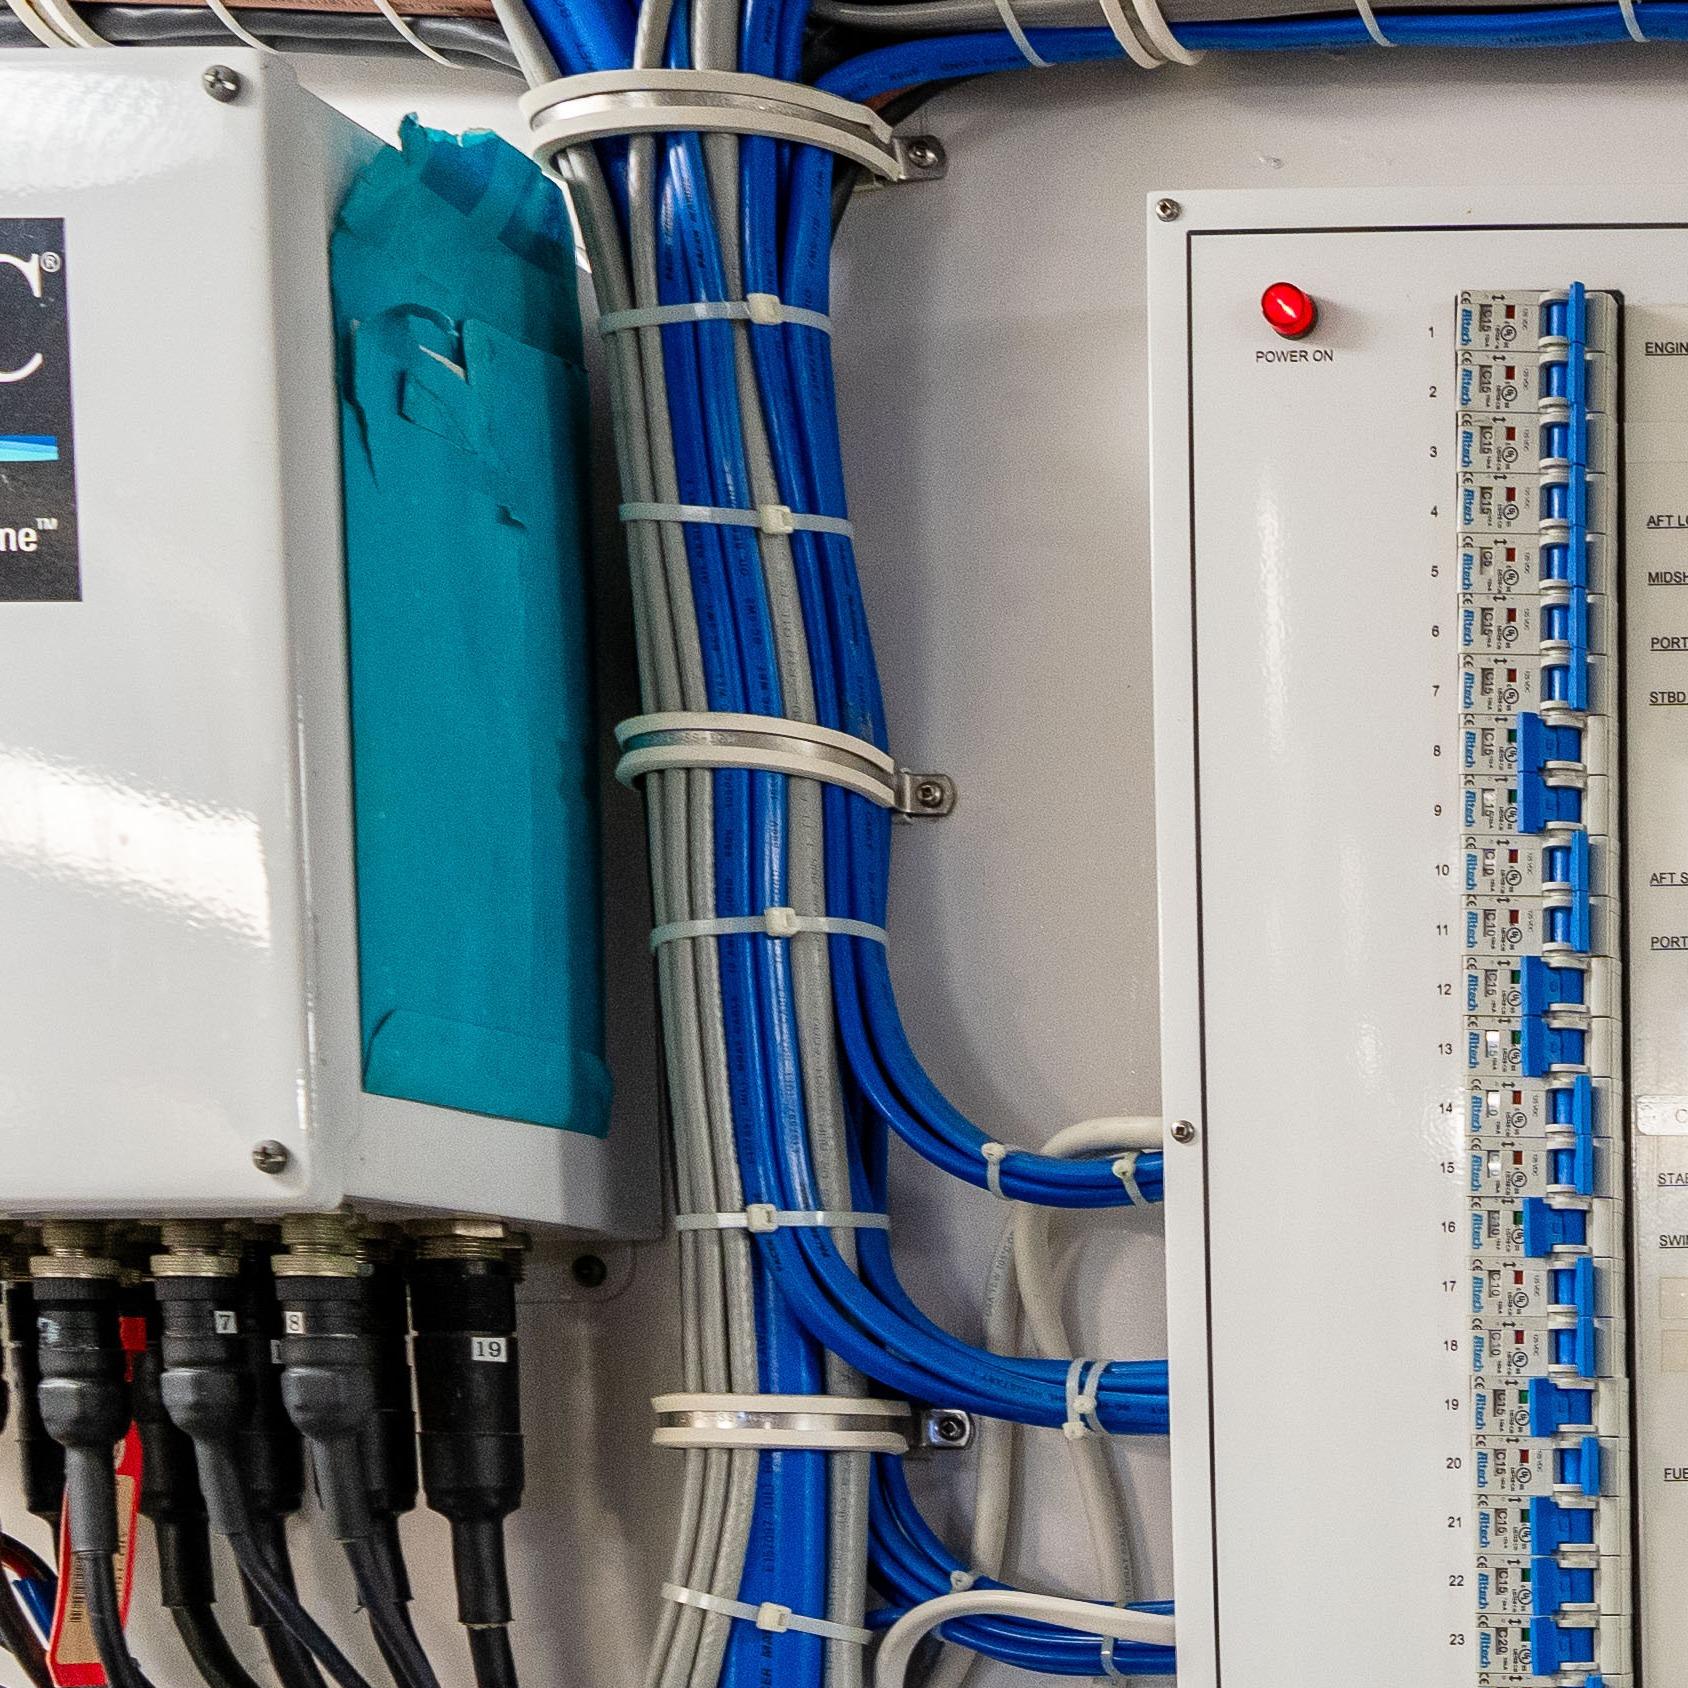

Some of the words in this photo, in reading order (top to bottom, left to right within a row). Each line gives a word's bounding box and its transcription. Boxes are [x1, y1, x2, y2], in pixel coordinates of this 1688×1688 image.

[1255, 349, 1309, 363] POWER
[1312, 349, 1334, 362] ON
[1646, 513, 1672, 528] AFT
[1649, 871, 1677, 885] AFT
[475, 1340, 503, 1358] 19
